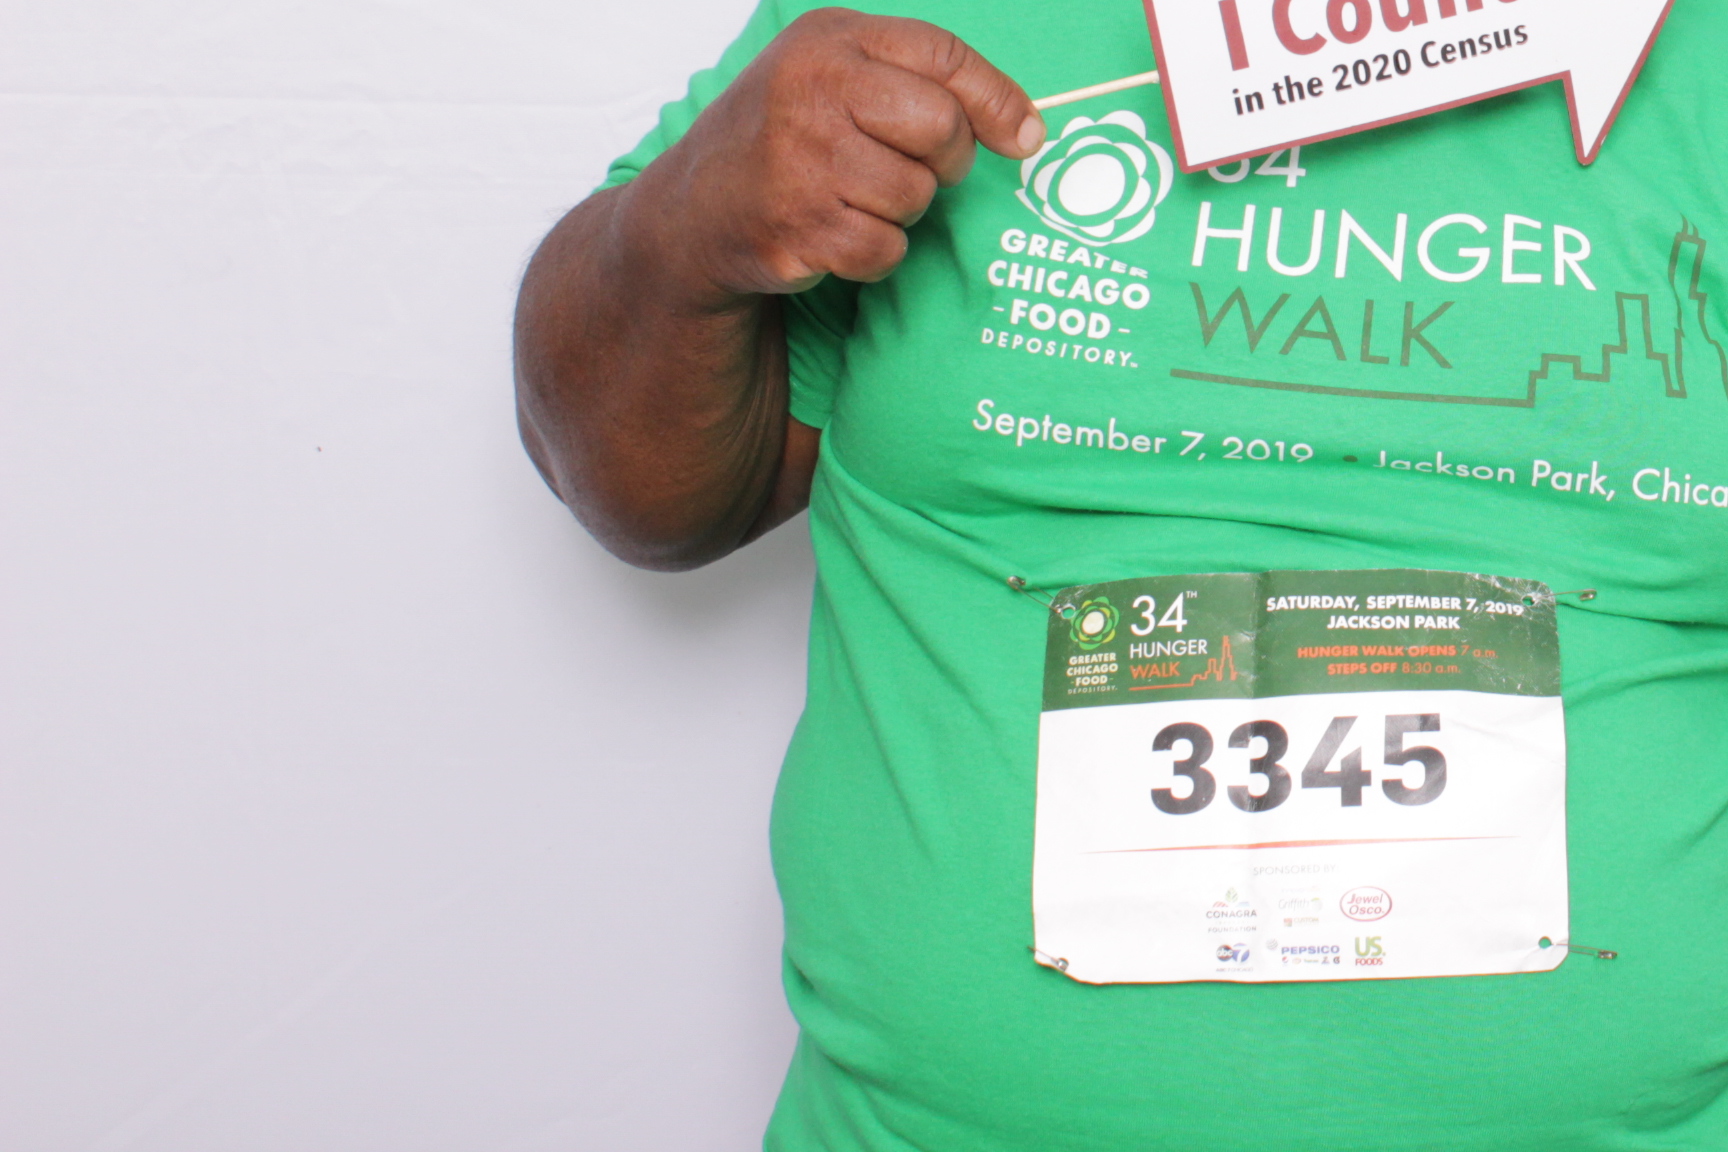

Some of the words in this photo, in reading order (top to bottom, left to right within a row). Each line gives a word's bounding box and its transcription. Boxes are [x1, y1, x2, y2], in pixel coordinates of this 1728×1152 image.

[1231, 88, 1265, 116] in
[1272, 71, 1324, 108] the
[1332, 48, 1412, 91] 2020
[1420, 24, 1529, 69] Census
[1000, 228, 1149, 279] GREATER
[1191, 201, 1597, 291] HUNGER
[986, 259, 1151, 310] CHICAGO
[1009, 298, 1112, 340] FOOD
[1188, 280, 1457, 370] WALK
[980, 327, 1133, 367] DEPOSITORY
[972, 398, 1168, 454] September
[1178, 430, 1206, 461] 7,
[1221, 436, 1315, 463] 2019
[1372, 450, 1516, 484] Jackson
[1530, 459, 1615, 502] Park,
[1266, 596, 1360, 611] SATURDAY,
[1366, 595, 1461, 611] SEPTEMBER
[1465, 598, 1479, 614] 7,
[1485, 600, 1525, 616] 2019
[1327, 615, 1410, 629] JACKSON
[1414, 615, 1460, 629] PARK
[1129, 639, 1208, 659] HUNGER
[1297, 645, 1359, 658] HUNGER
[1362, 645, 1405, 657] WALK
[1407, 644, 1457, 657] OPENS
[1460, 645, 1470, 656] 7
[1472, 648, 1499, 658] a.m.
[1068, 652, 1117, 666] GREATER
[1327, 663, 1367, 675] STEPS
[1370, 662, 1398, 674] OFF
[1402, 662, 1432, 674] 8:30
[1435, 663, 1462, 674] a.m.
[1066, 663, 1119, 677] CHICAGO
[1129, 661, 1182, 679] WALK
[1150, 712, 1448, 816] 3345
[1253, 864, 1321, 876] SPONSORED
[1347, 893, 1383, 905] Jewel
[1206, 909, 1258, 919] CONAGRA
[1208, 925, 1257, 934] FOUNDATION
[1281, 945, 1340, 955] PEPSICO
[1355, 957, 1384, 966] FOODS
